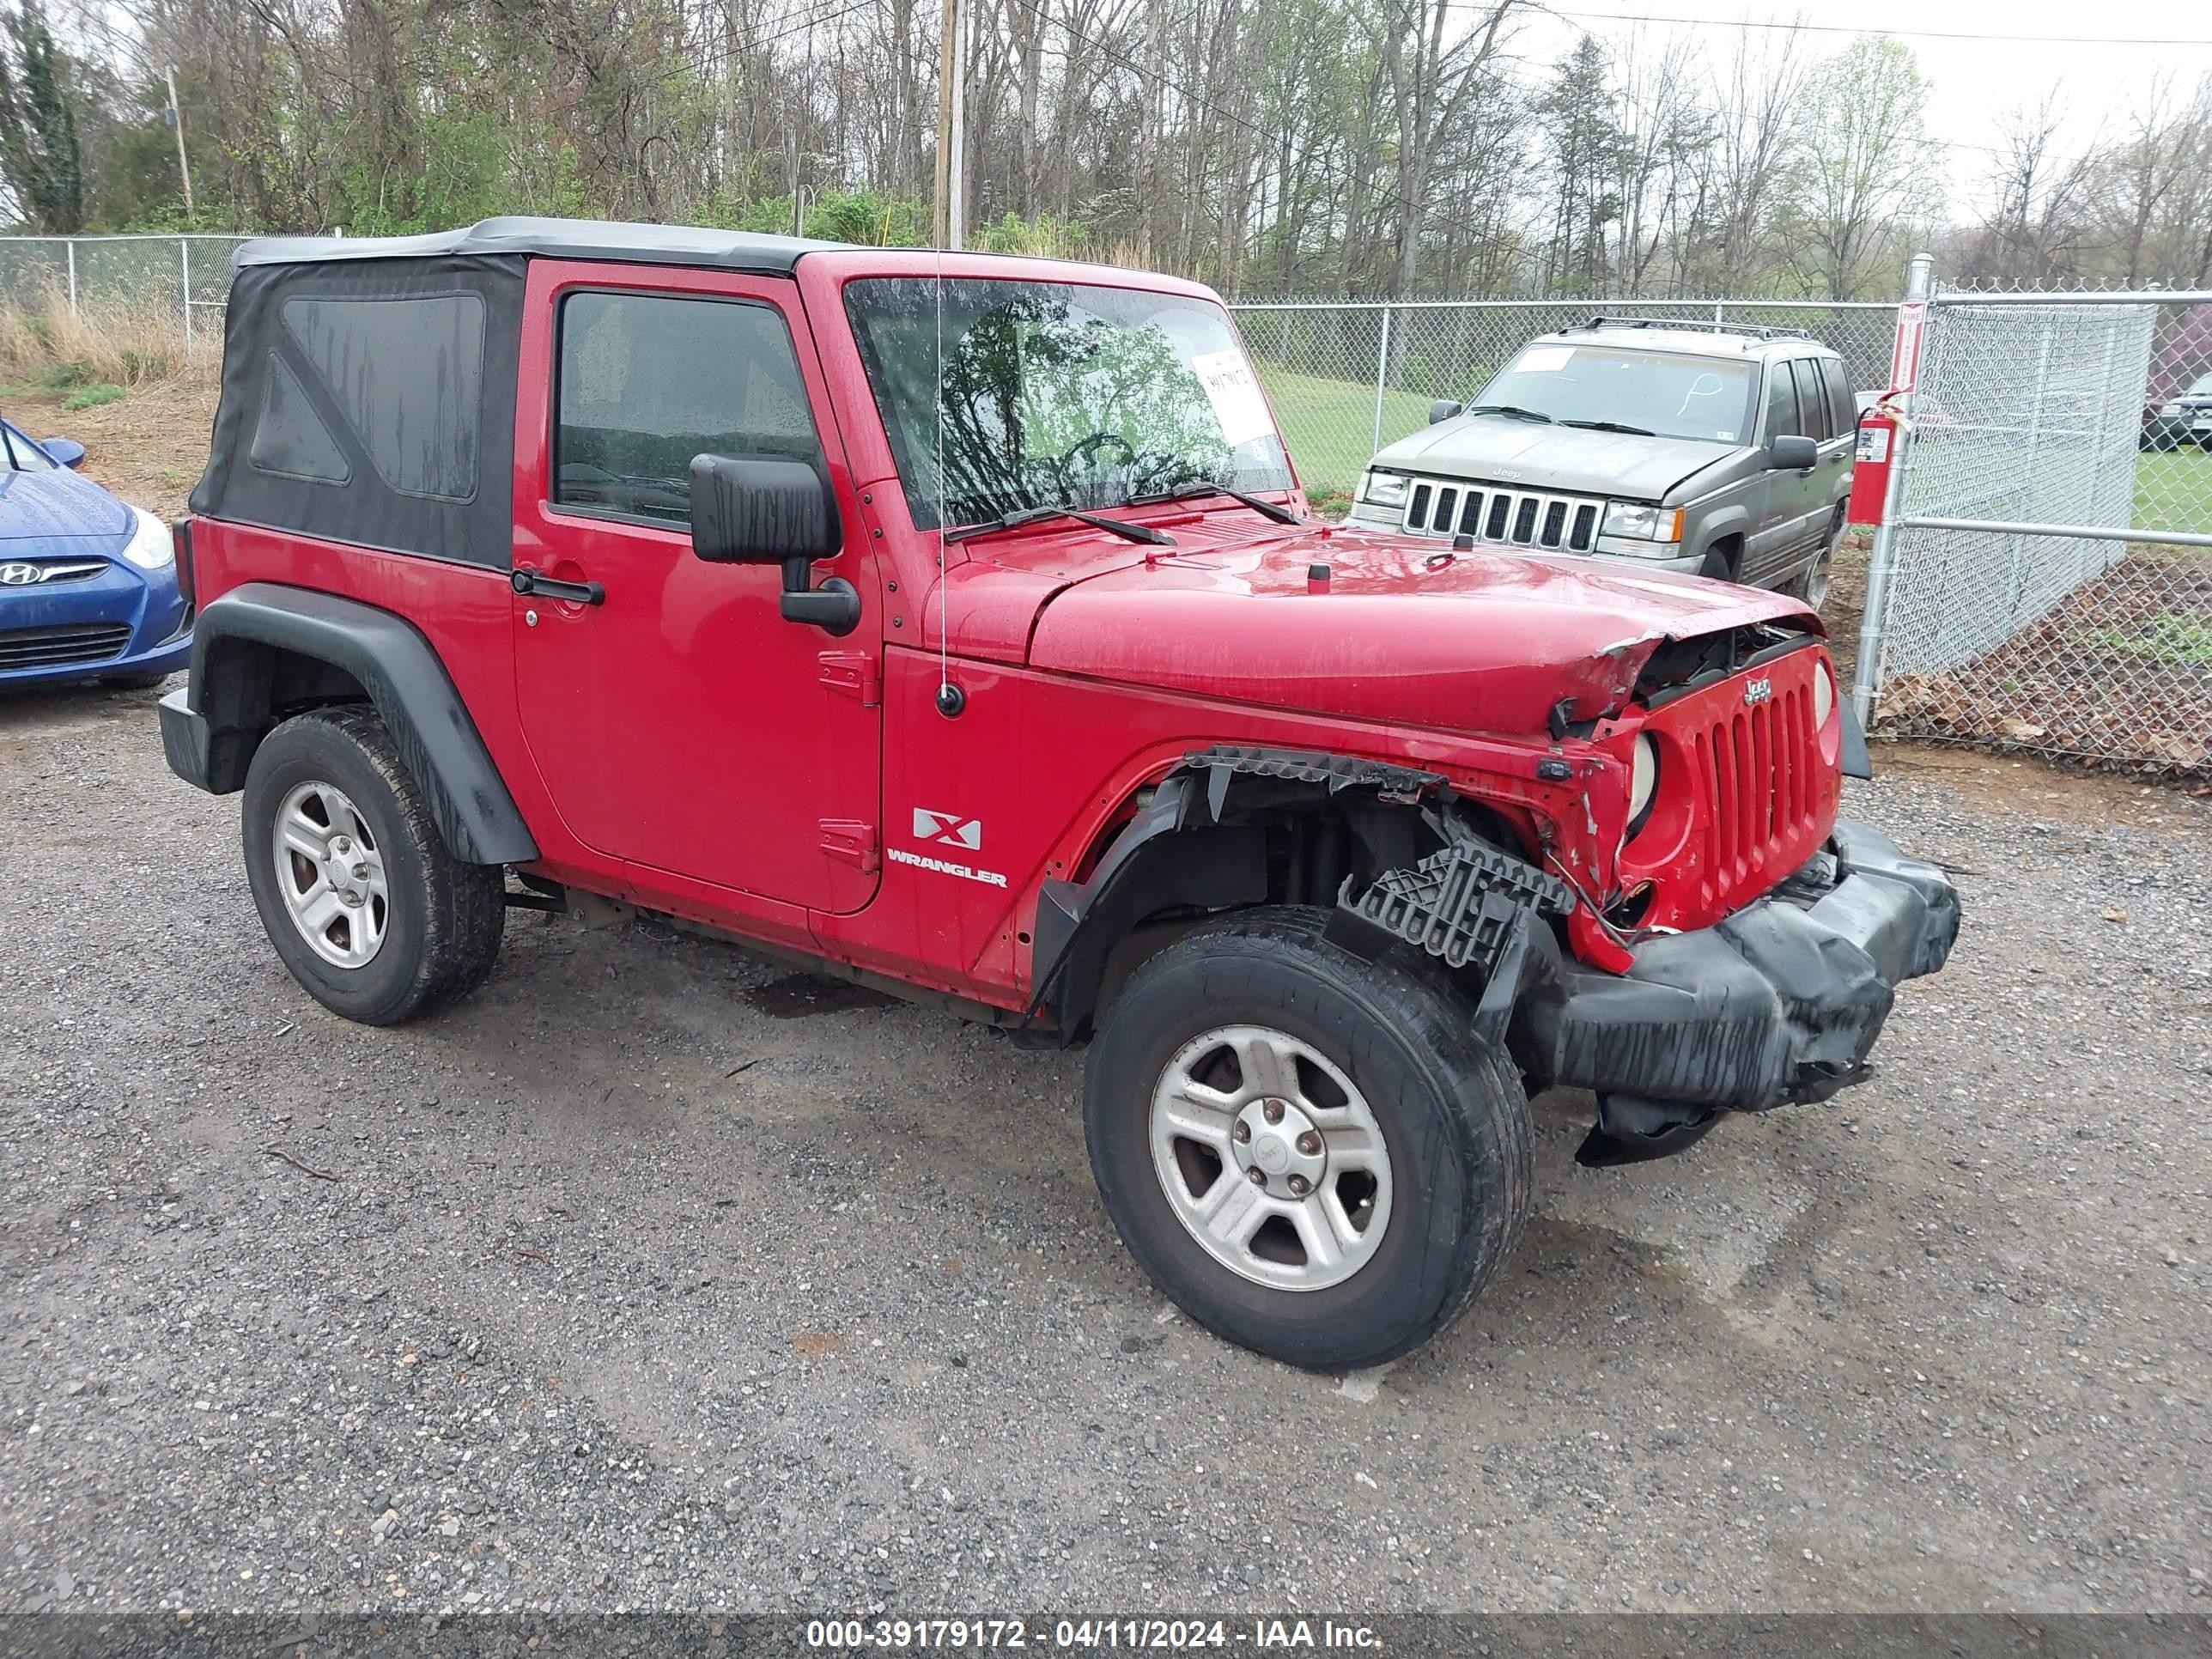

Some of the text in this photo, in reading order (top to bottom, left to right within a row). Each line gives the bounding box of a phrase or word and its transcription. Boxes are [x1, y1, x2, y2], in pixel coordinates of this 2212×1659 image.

[1903, 313, 1922, 321] FIRE
[1492, 467, 1522, 480] Jeep
[1744, 678, 1771, 706] Jeep
[887, 848, 1008, 889] WRANGLER
